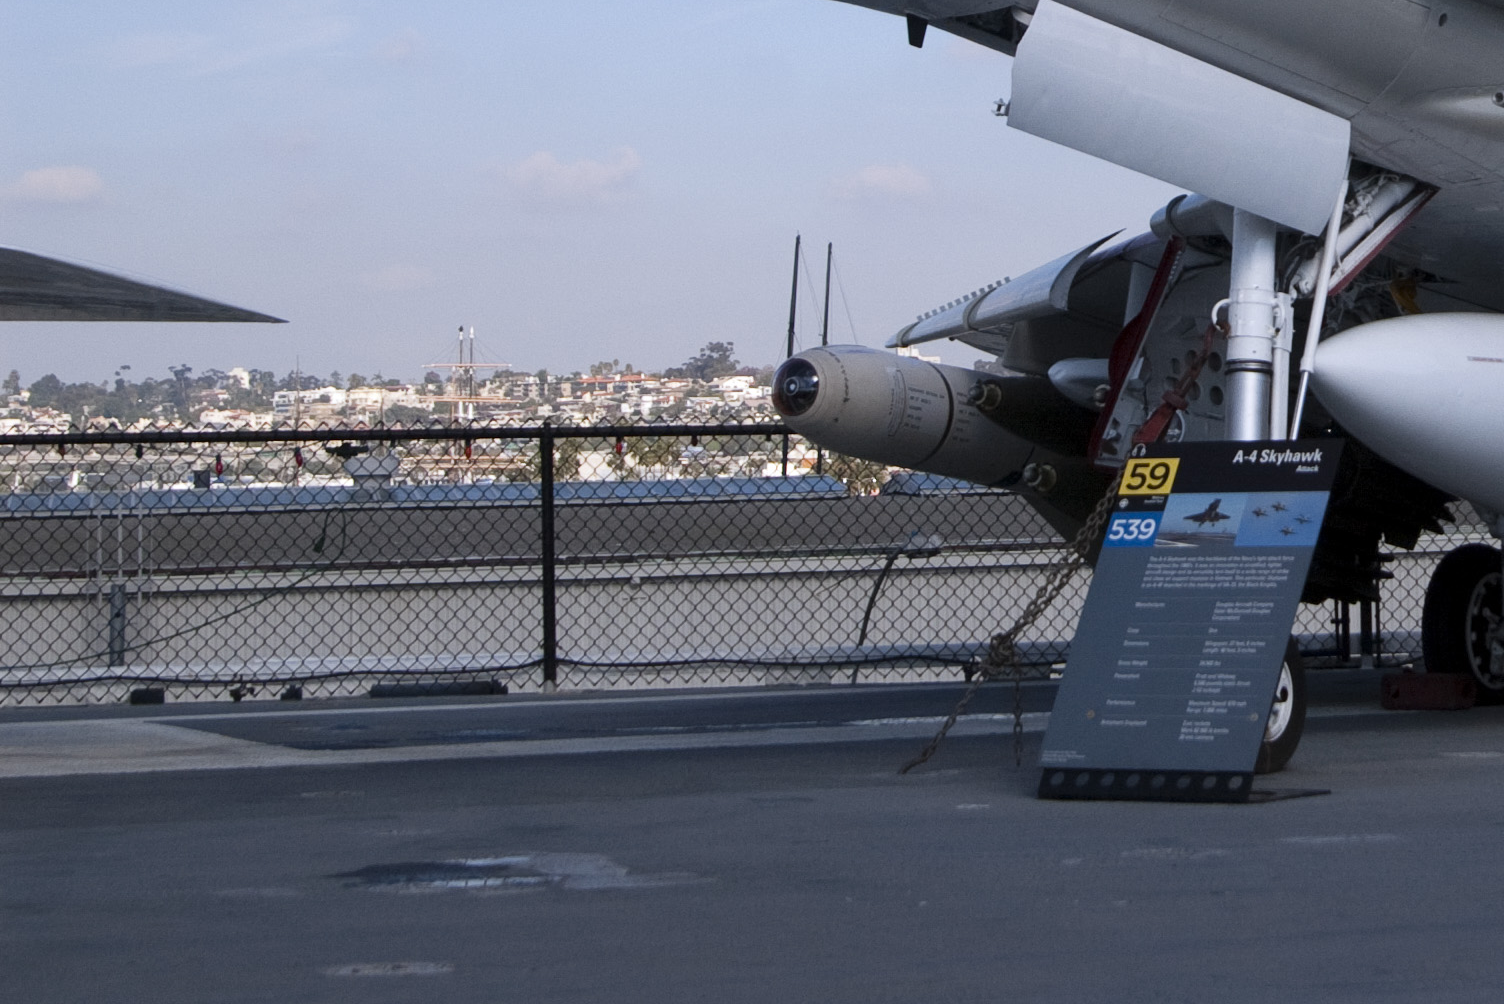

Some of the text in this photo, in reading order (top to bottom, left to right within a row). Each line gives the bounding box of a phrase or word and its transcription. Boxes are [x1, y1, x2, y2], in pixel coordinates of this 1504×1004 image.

[1232, 448, 1322, 466] A-4 Skyhawk
[1126, 462, 1170, 490] 59
[1296, 465, 1319, 473] Attack
[1108, 518, 1156, 540] 539
